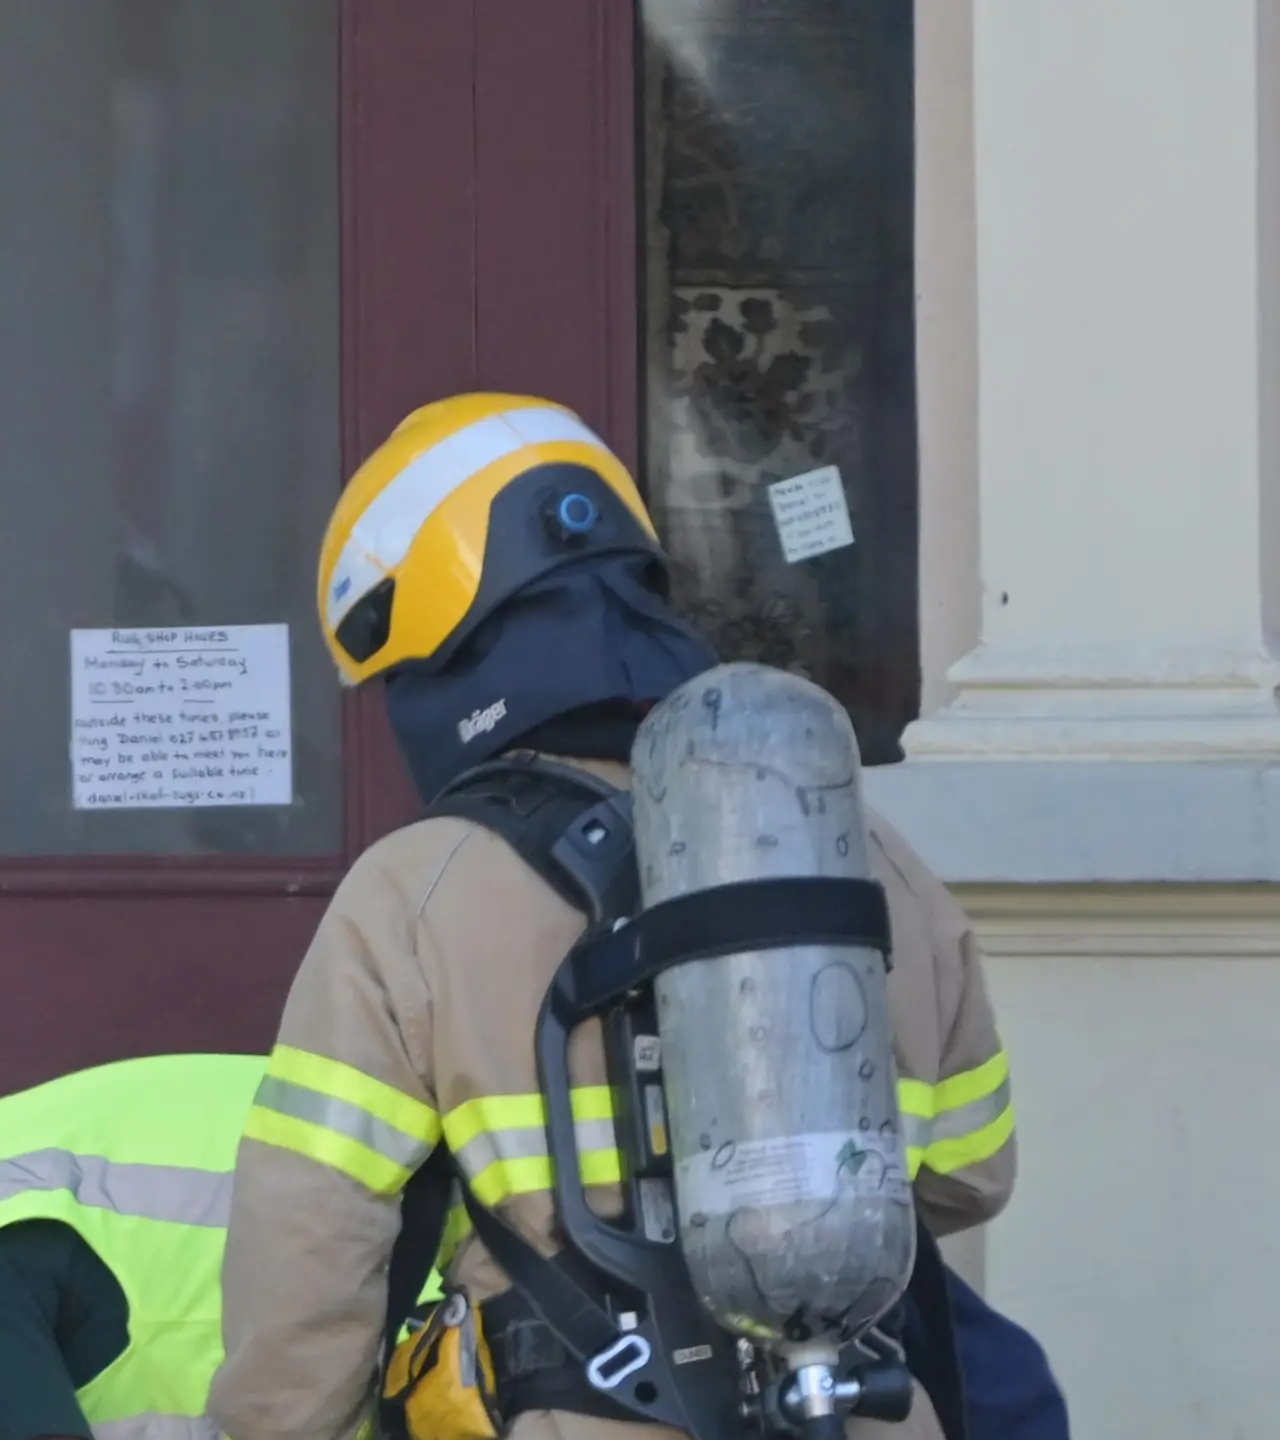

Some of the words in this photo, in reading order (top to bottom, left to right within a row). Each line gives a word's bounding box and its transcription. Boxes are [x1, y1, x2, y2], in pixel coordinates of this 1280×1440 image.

[145, 630, 178, 643] SHOP
[184, 630, 230, 643] HOURS
[84, 656, 145, 676] Monday
[153, 657, 169, 670] to
[176, 654, 248, 675] Saturday
[158, 679, 174, 693] to
[133, 711, 173, 724] these
[179, 711, 219, 724] times
[228, 711, 270, 723] please
[458, 698, 507, 744] Dräger
[117, 731, 163, 744] Daniel
[169, 731, 195, 744] 027
[81, 753, 111, 767] may
[118, 752, 134, 764] be
[141, 749, 169, 762] able
[173, 751, 189, 761] to
[193, 748, 225, 759] meet
[257, 744, 288, 759] here
[98, 771, 146, 784] arrange
[152, 770, 163, 780] a
[229, 766, 259, 777] time
